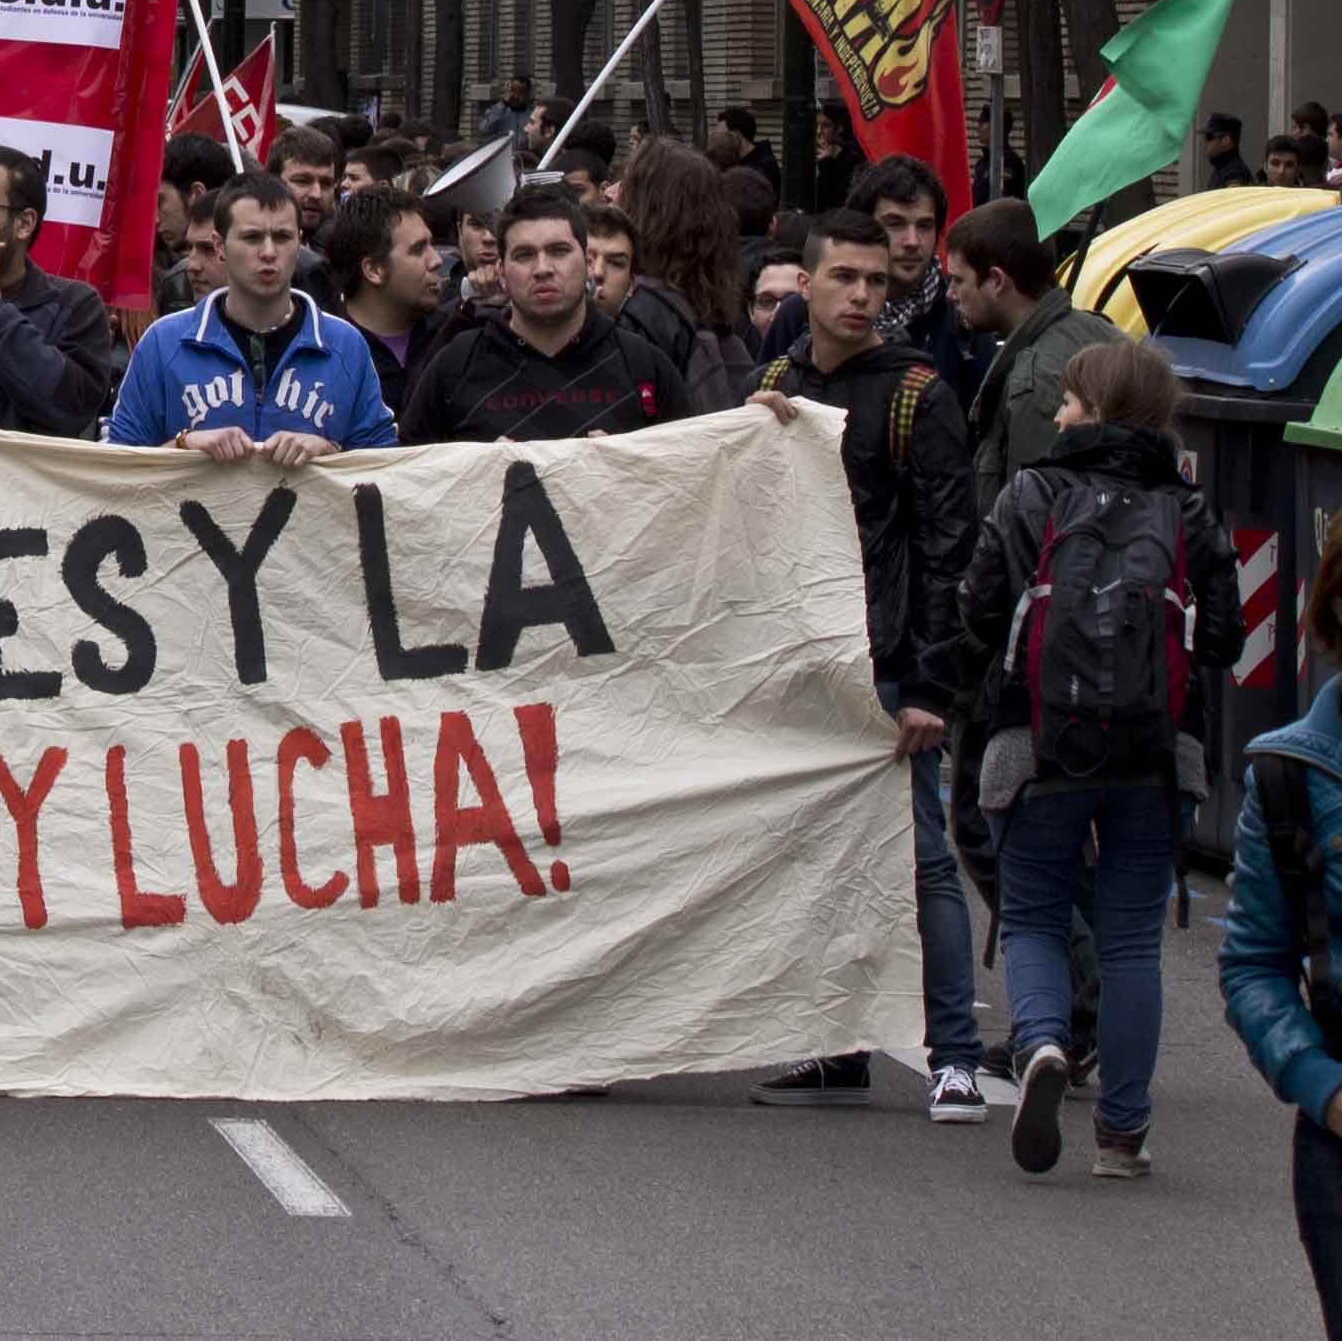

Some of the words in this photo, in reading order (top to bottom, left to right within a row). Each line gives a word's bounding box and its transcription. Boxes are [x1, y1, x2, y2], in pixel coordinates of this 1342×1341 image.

[178, 484, 298, 686] Y
[353, 459, 618, 681] LA
[105, 701, 572, 929] LUCHA!
